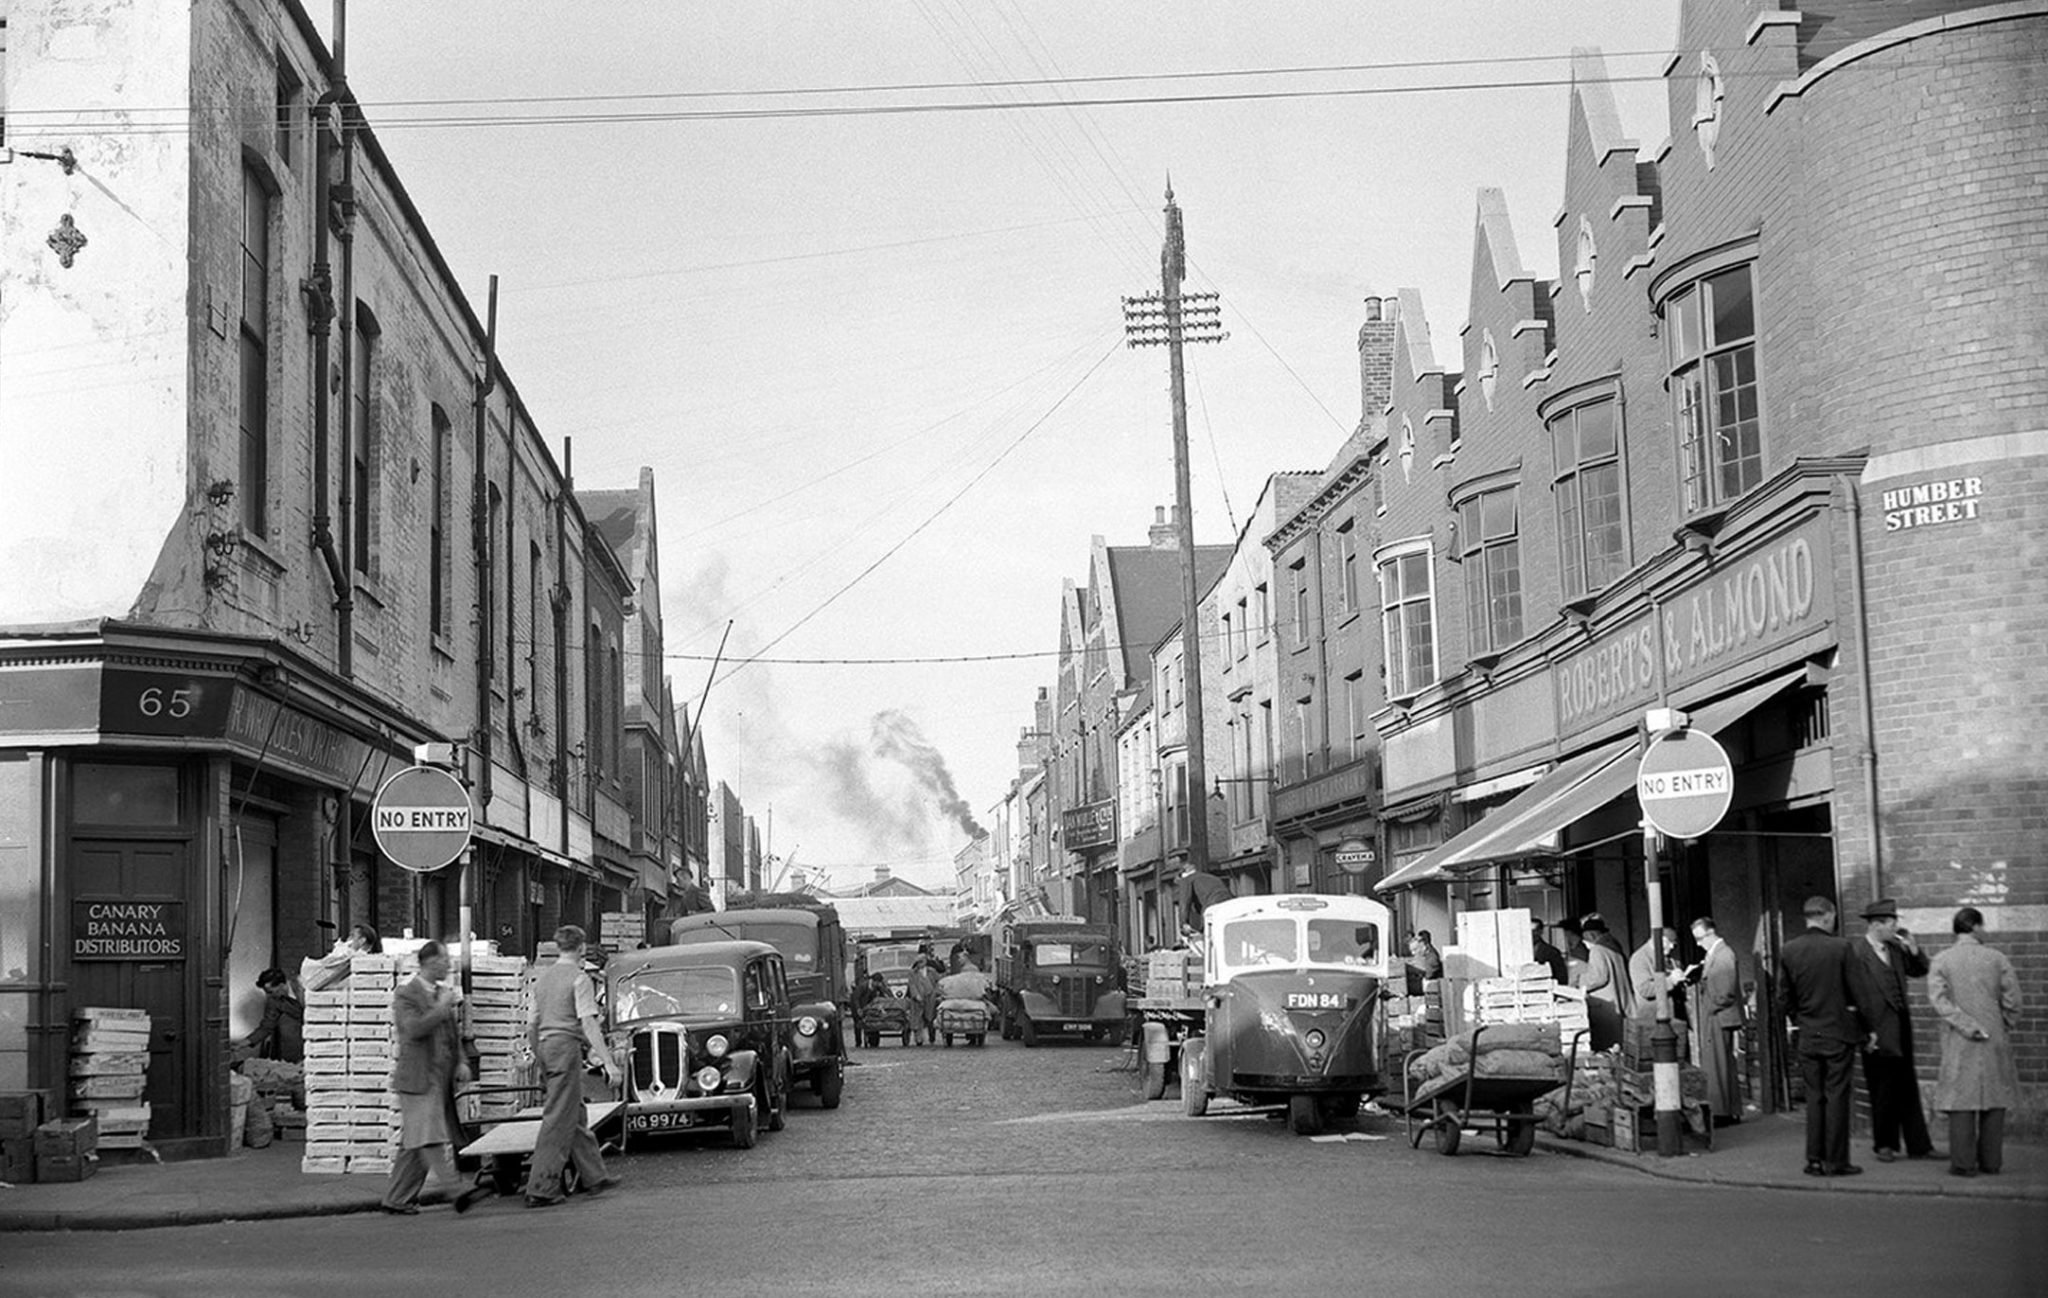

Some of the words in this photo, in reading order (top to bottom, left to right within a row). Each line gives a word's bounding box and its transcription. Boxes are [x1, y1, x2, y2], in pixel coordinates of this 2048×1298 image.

[1883, 477, 1983, 510] HUMBER
[1886, 499, 1979, 531] STREET
[1560, 624, 1653, 723] ROBERTS
[1665, 610, 1682, 676] &
[1689, 538, 1814, 667] ALMOND
[140, 688, 190, 717] 65
[1644, 778, 1666, 794] NO
[1672, 772, 1724, 792] ENTRY
[380, 811, 405, 827] NO
[411, 811, 467, 827] ENTRY
[89, 904, 162, 919] CANARY
[88, 922, 166, 936] BANANA
[75, 939, 181, 954] DISTRIBUTORS
[1288, 993, 1318, 1007] FDN
[1320, 993, 1339, 1007] 84
[628, 1115, 647, 1129] HG
[649, 1113, 689, 1128] 9974
